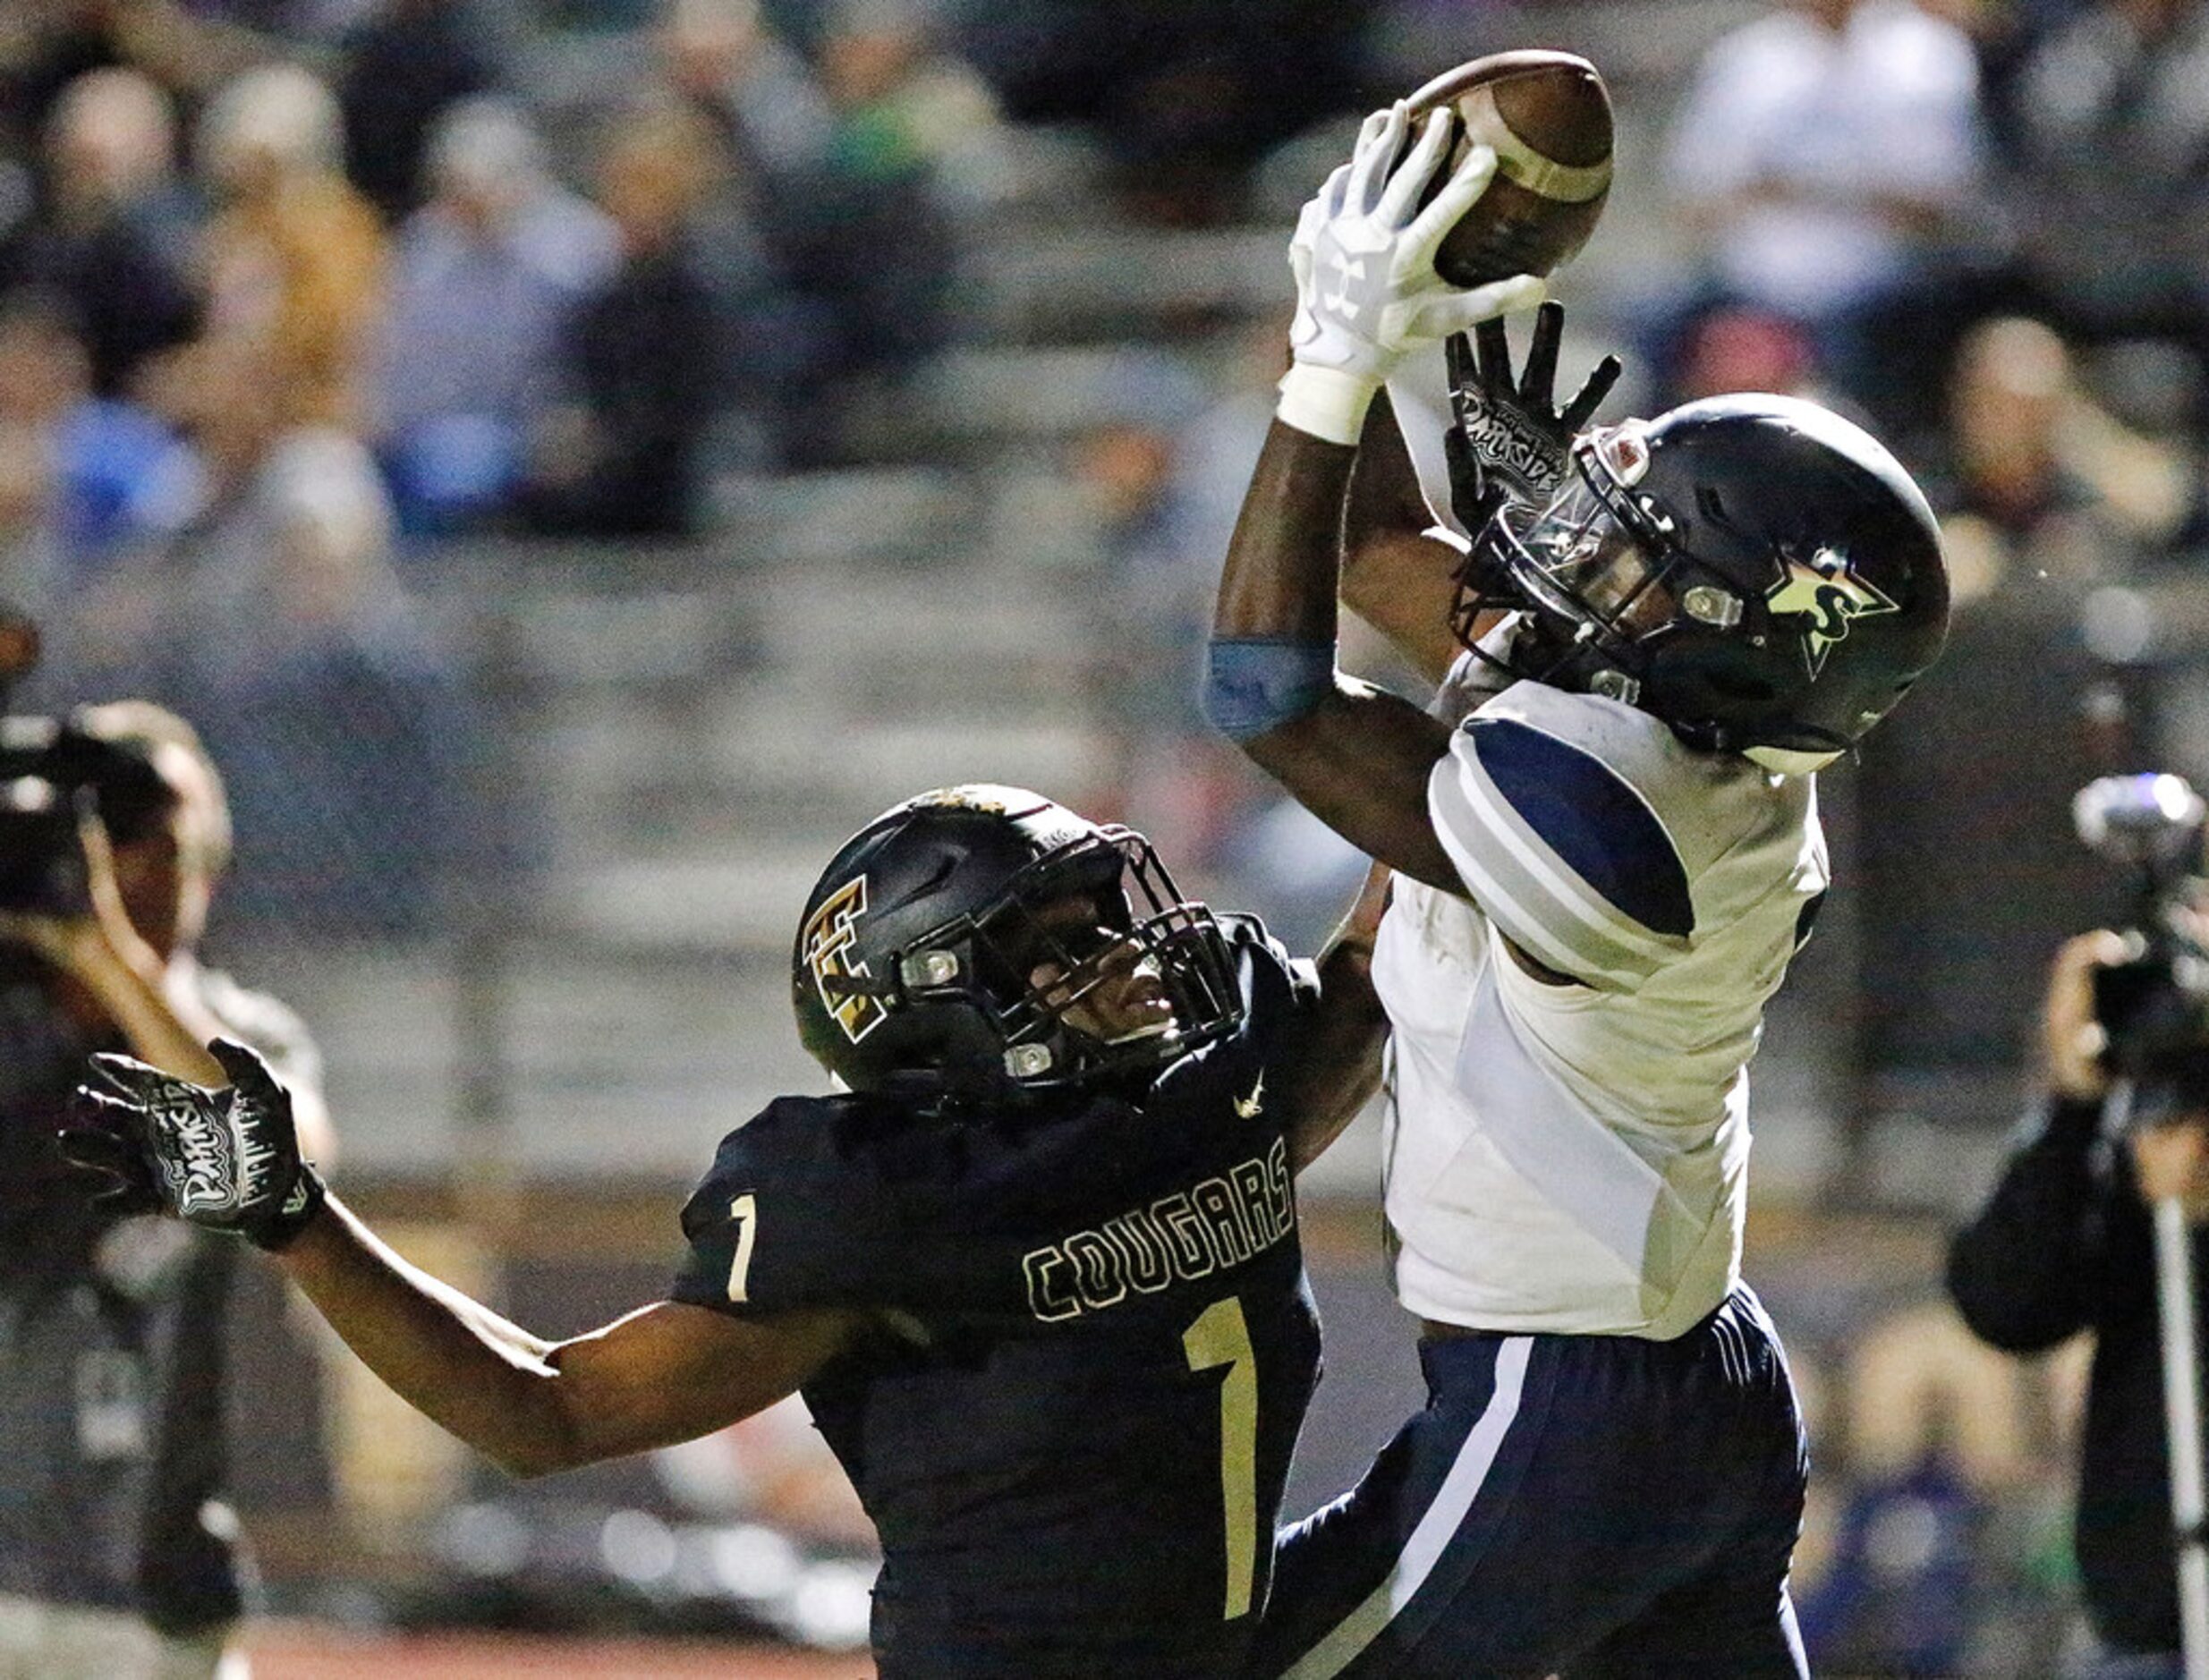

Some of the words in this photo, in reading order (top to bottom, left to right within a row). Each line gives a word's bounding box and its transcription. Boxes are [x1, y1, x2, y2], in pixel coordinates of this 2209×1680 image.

[727, 1192, 757, 1302] 1
[1022, 1133, 1294, 1322] COUGARS
[1181, 1295, 1259, 1620] 1
